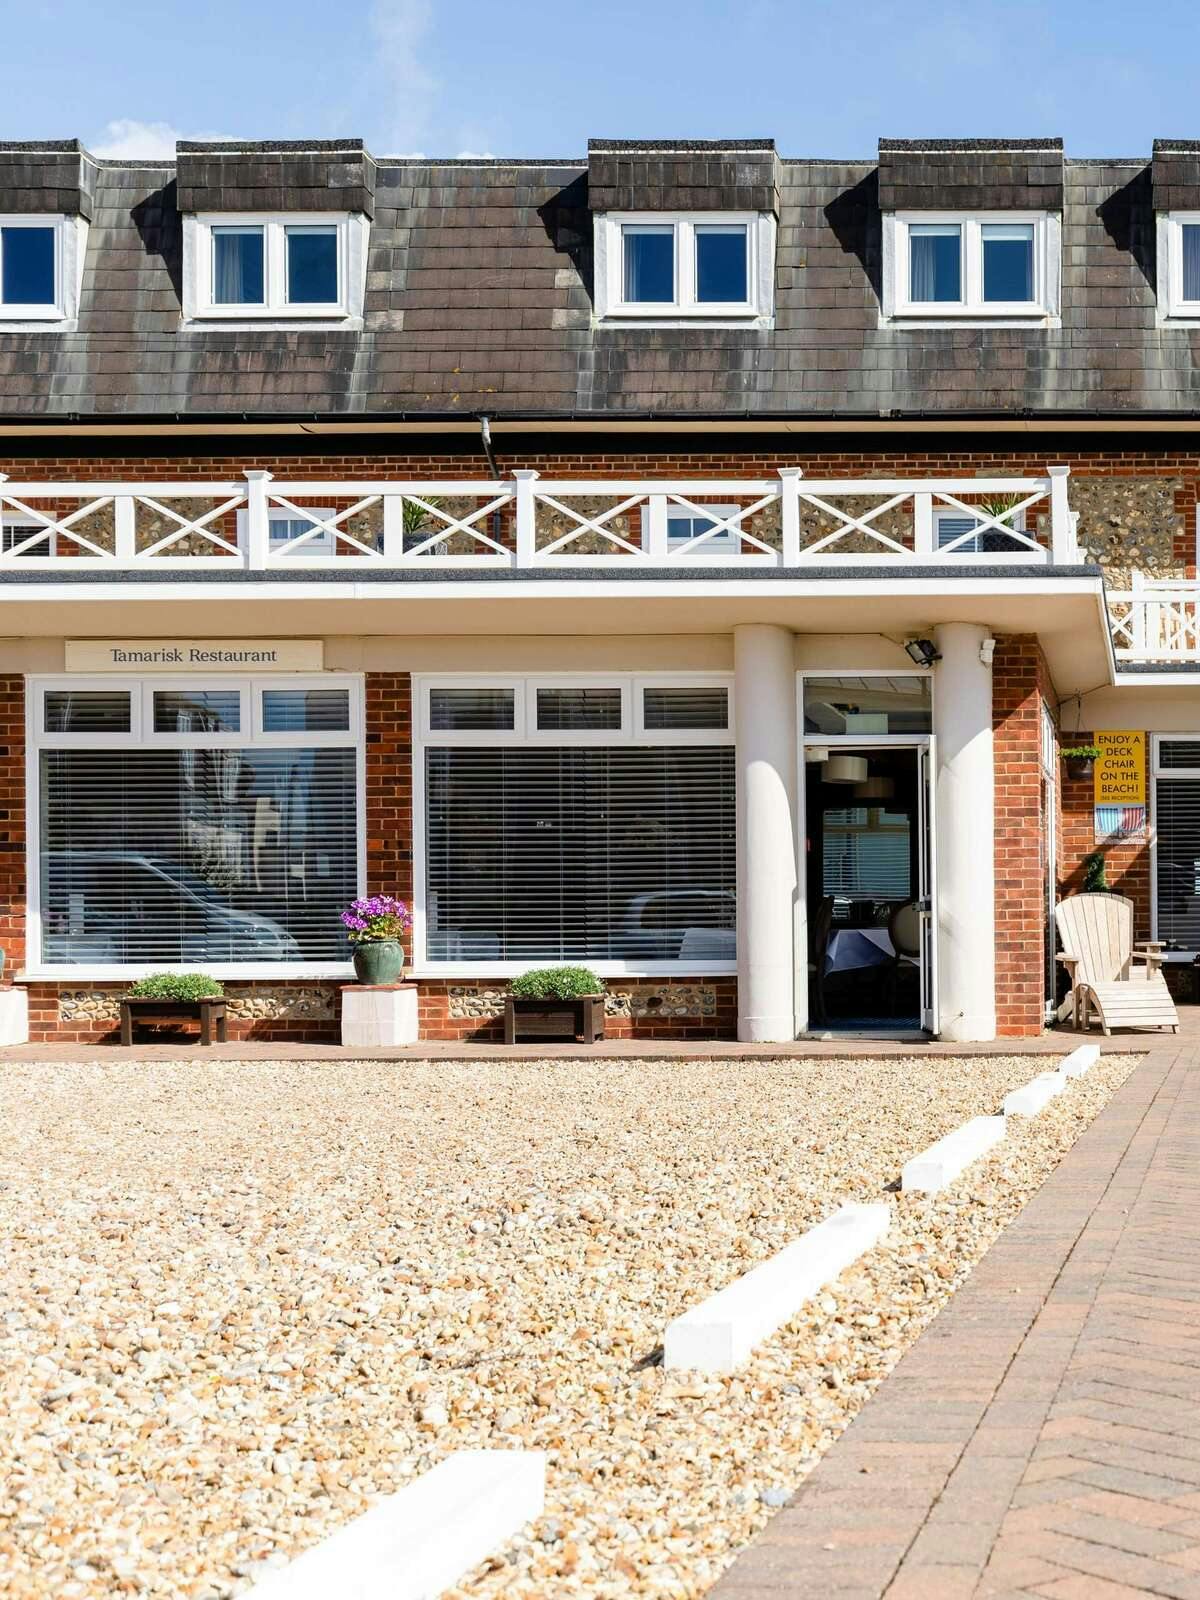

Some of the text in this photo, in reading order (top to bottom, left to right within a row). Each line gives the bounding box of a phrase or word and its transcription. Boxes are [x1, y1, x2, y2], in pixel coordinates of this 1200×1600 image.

[110, 648, 277, 662] Tamarisk Restaurant
[1098, 735, 1141, 744] ENJOY A
[1106, 747, 1133, 756] DECK
[1104, 759, 1135, 768] CHAIR
[1100, 771, 1139, 781] ON THE
[1101, 784, 1139, 793] BEACH!
